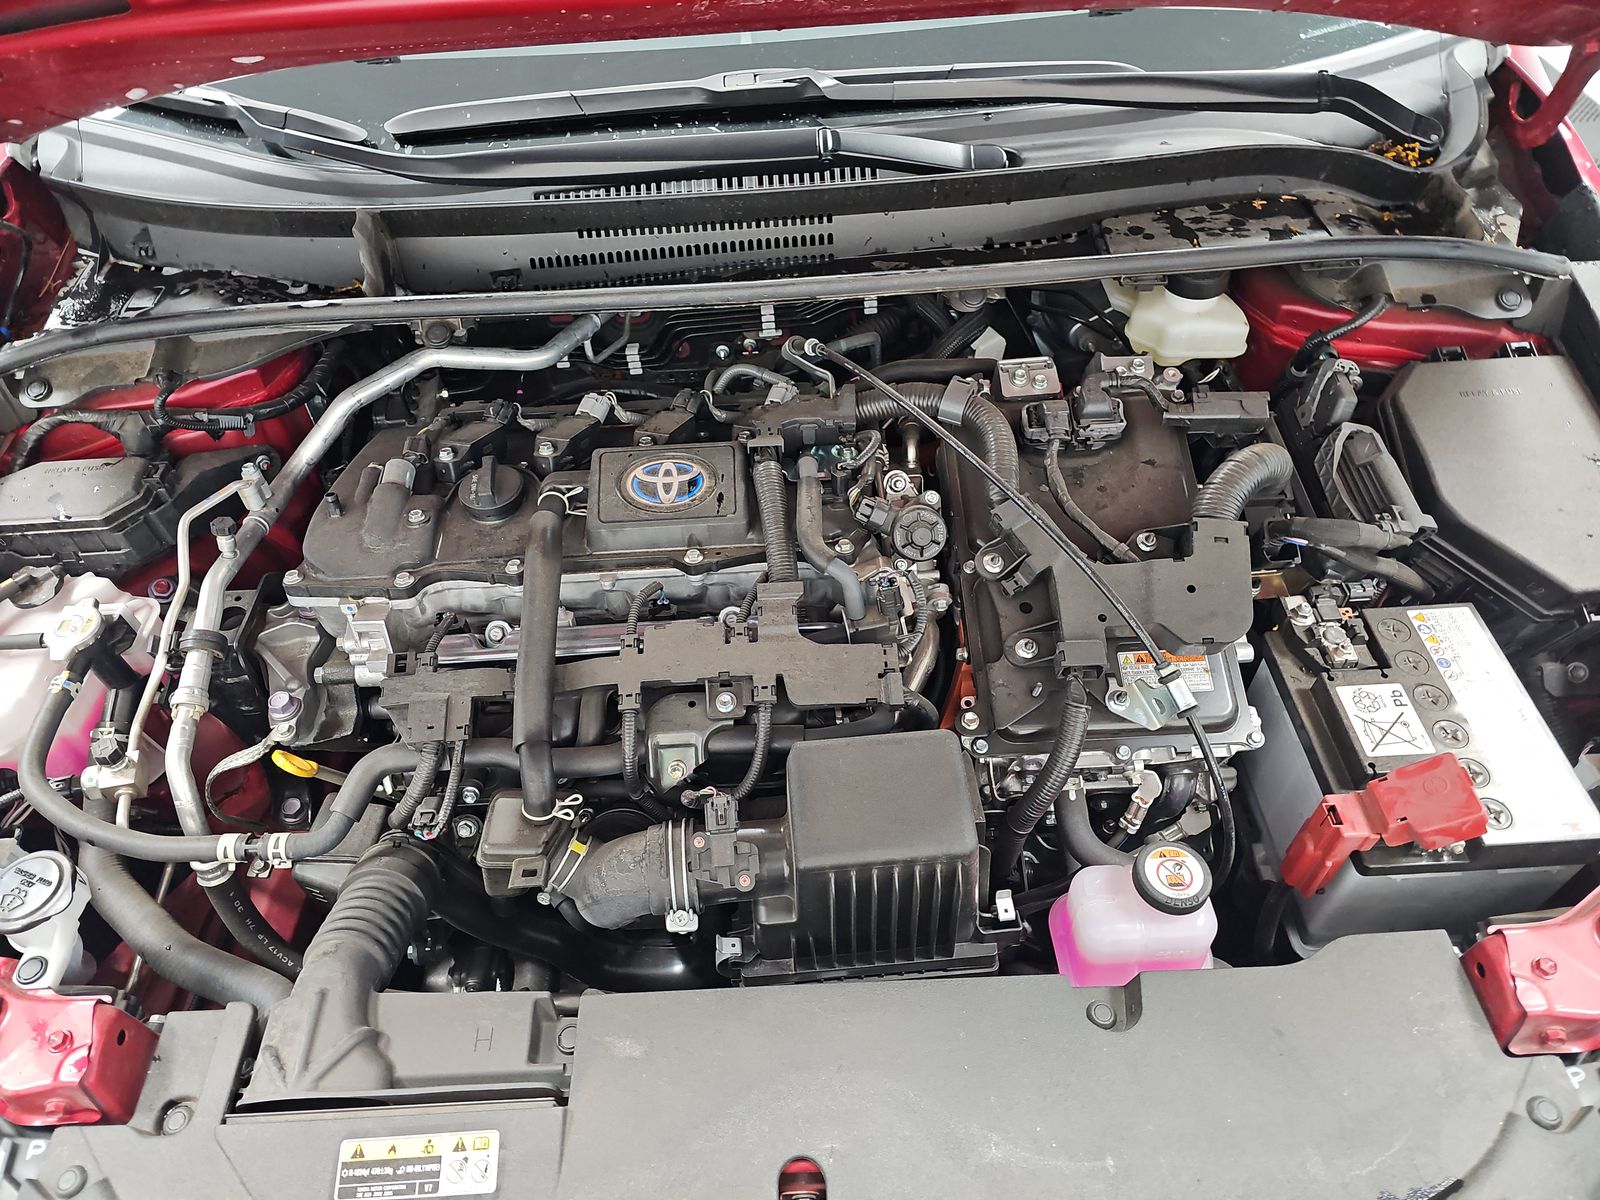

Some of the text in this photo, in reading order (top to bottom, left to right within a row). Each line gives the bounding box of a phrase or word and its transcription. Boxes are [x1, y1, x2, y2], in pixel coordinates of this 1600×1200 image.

[1390, 690, 1409, 707] Pb
[1165, 896, 1200, 907] DENSO
[257, 933, 270, 945] LP
[267, 945, 295, 967] ACV17
